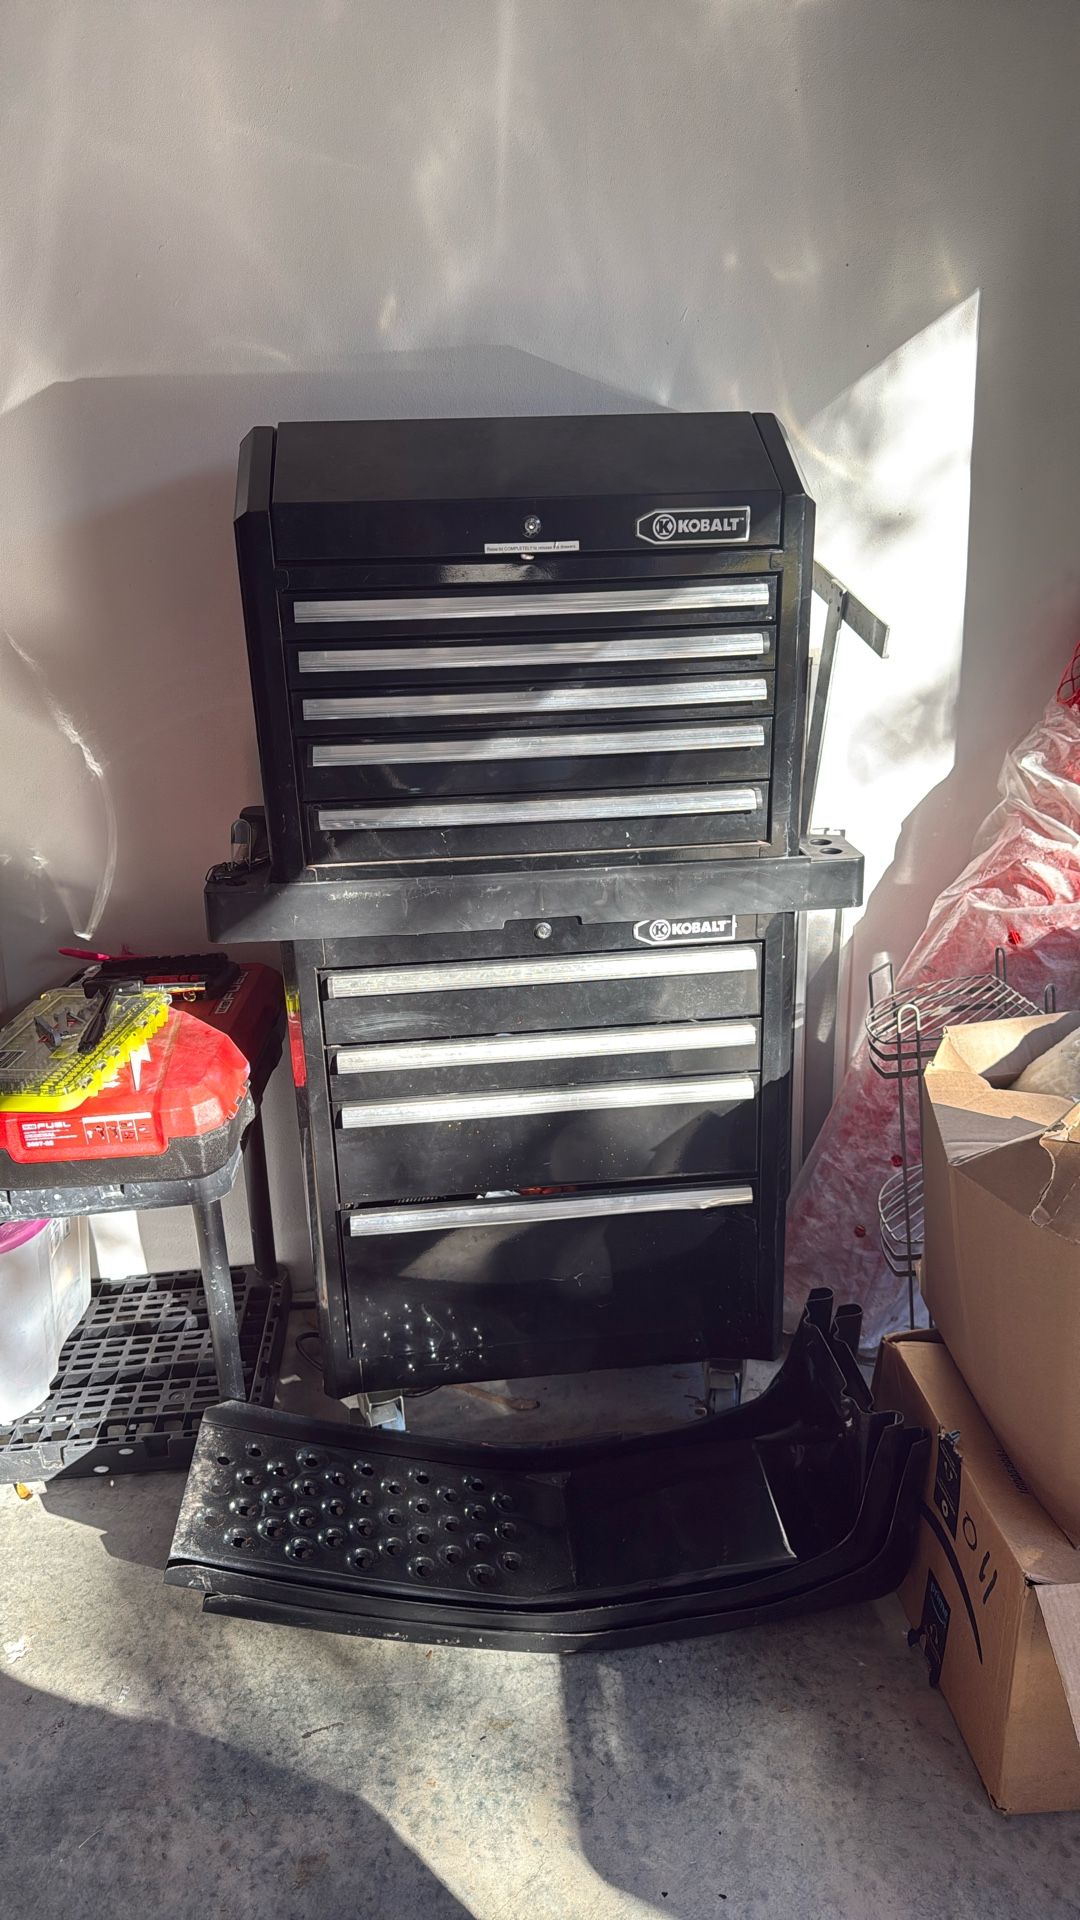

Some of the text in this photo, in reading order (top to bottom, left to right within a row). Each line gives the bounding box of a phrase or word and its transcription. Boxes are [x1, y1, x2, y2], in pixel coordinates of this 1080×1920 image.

[678, 518, 740, 533] KOBALT
[672, 920, 727, 935] KOBALT
[37, 1121, 72, 1130] FUEL
